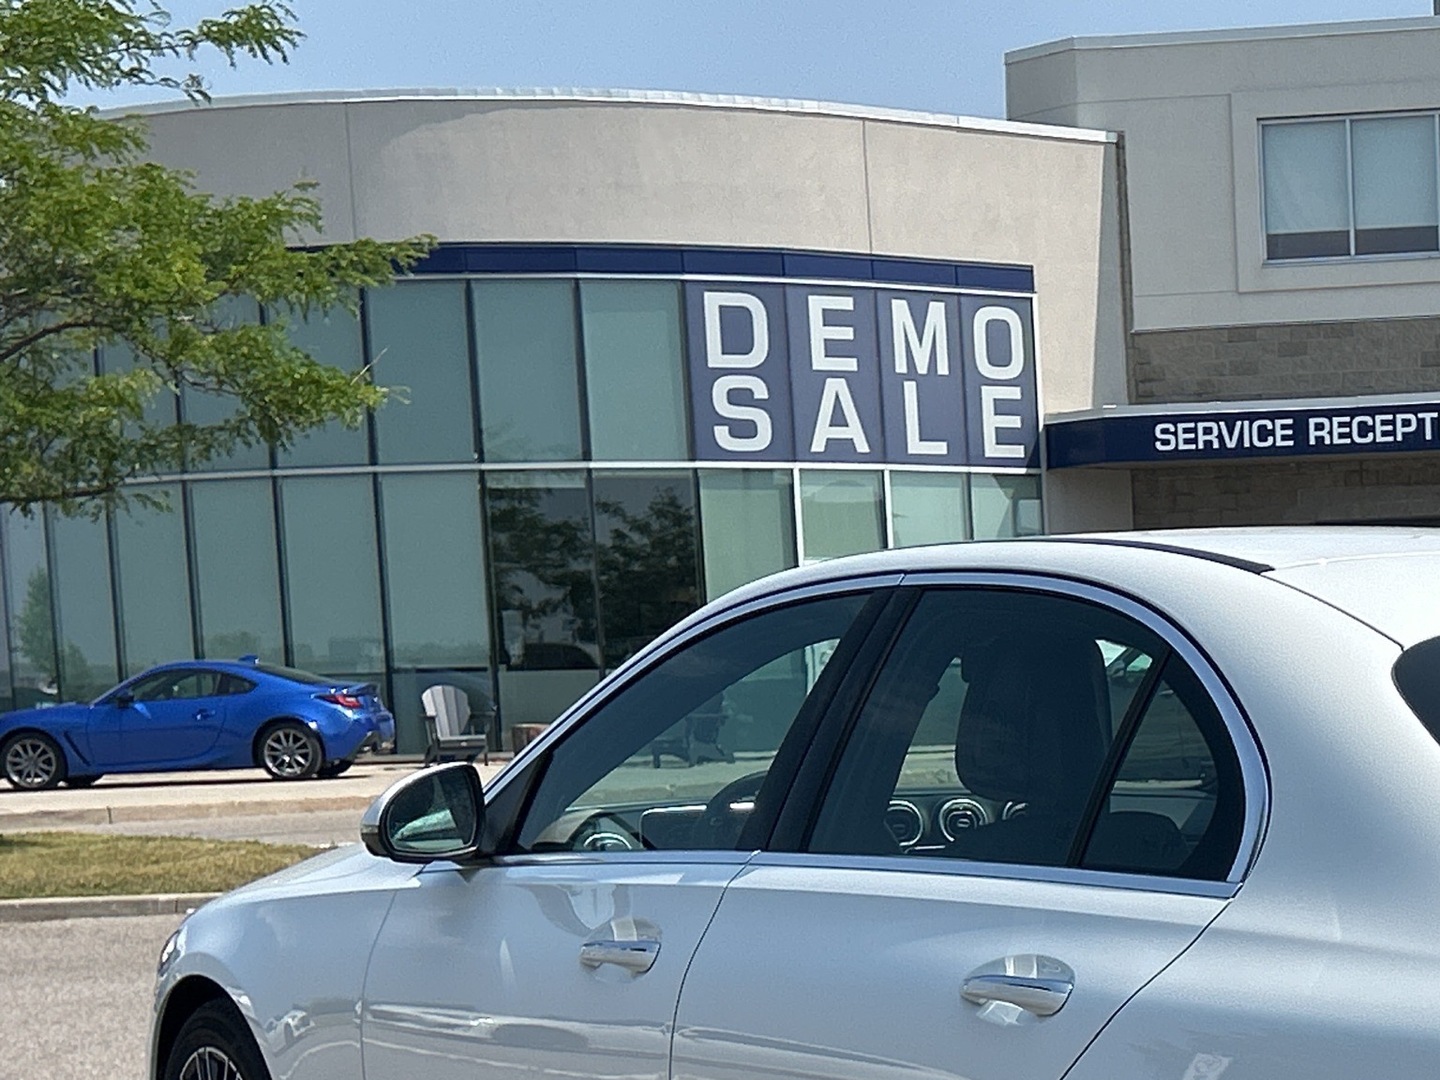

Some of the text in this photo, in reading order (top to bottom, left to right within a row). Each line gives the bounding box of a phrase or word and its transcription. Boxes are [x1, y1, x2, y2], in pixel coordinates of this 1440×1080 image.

[703, 291, 1025, 381] DEMO
[711, 375, 1026, 459] SALE
[1154, 418, 1295, 451] SERVICE
